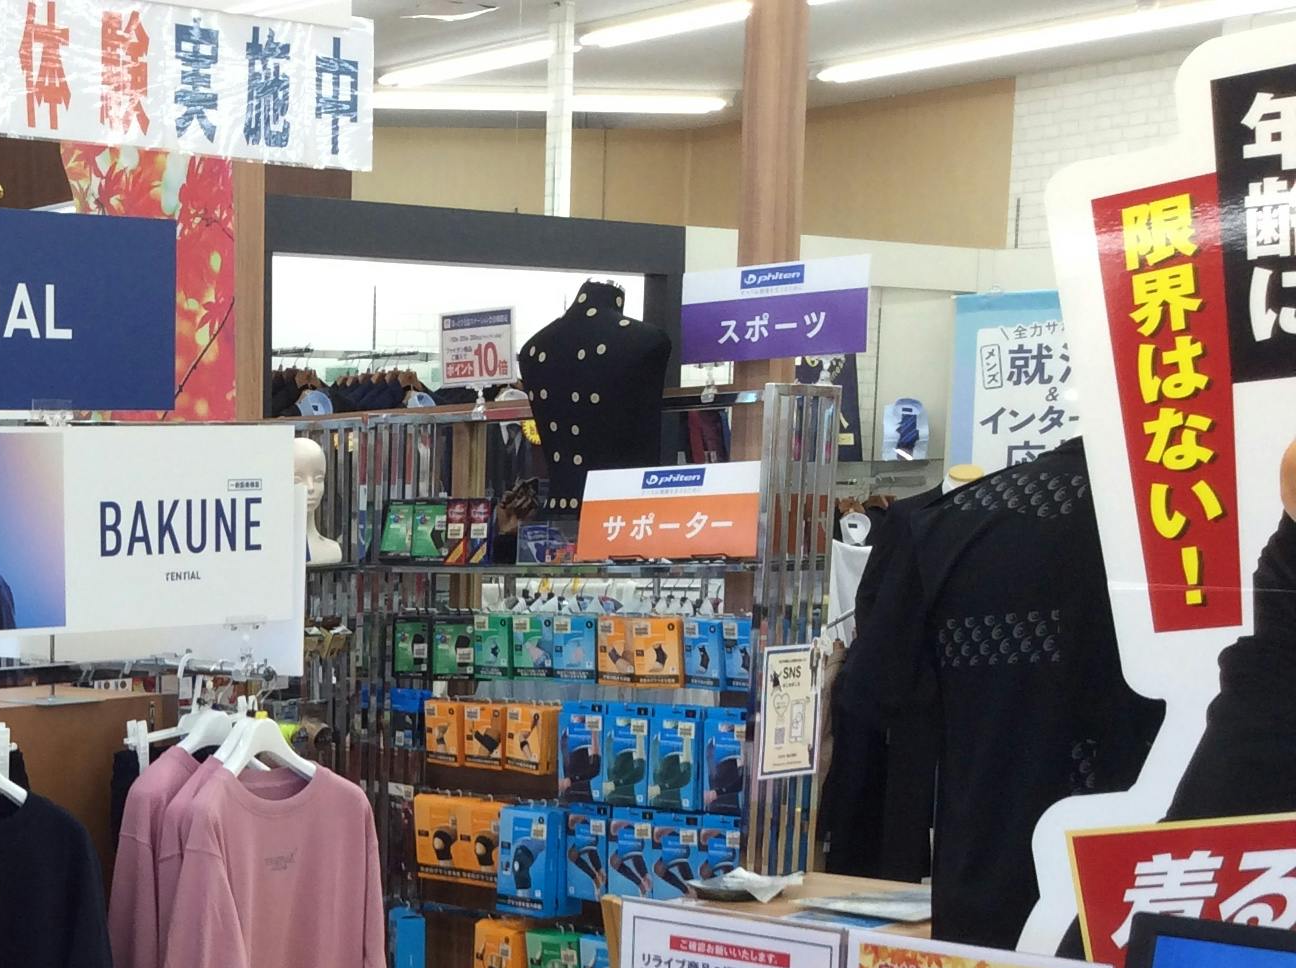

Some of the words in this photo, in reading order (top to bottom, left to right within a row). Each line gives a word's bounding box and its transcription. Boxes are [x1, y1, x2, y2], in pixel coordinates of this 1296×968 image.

[757, 271, 801, 285] phiten
[718, 311, 826, 345] スポーツ
[1014, 322, 1065, 340] 全力サ
[447, 362, 473, 377] ポイント
[985, 347, 999, 385] メンズ
[658, 474, 701, 485] phiten
[99, 497, 263, 558] BAKUNE
[603, 511, 733, 542] サポーター
[165, 570, 201, 582] TENTIAL
[783, 666, 801, 680] SNS
[1111, 849, 1296, 950] 着る
